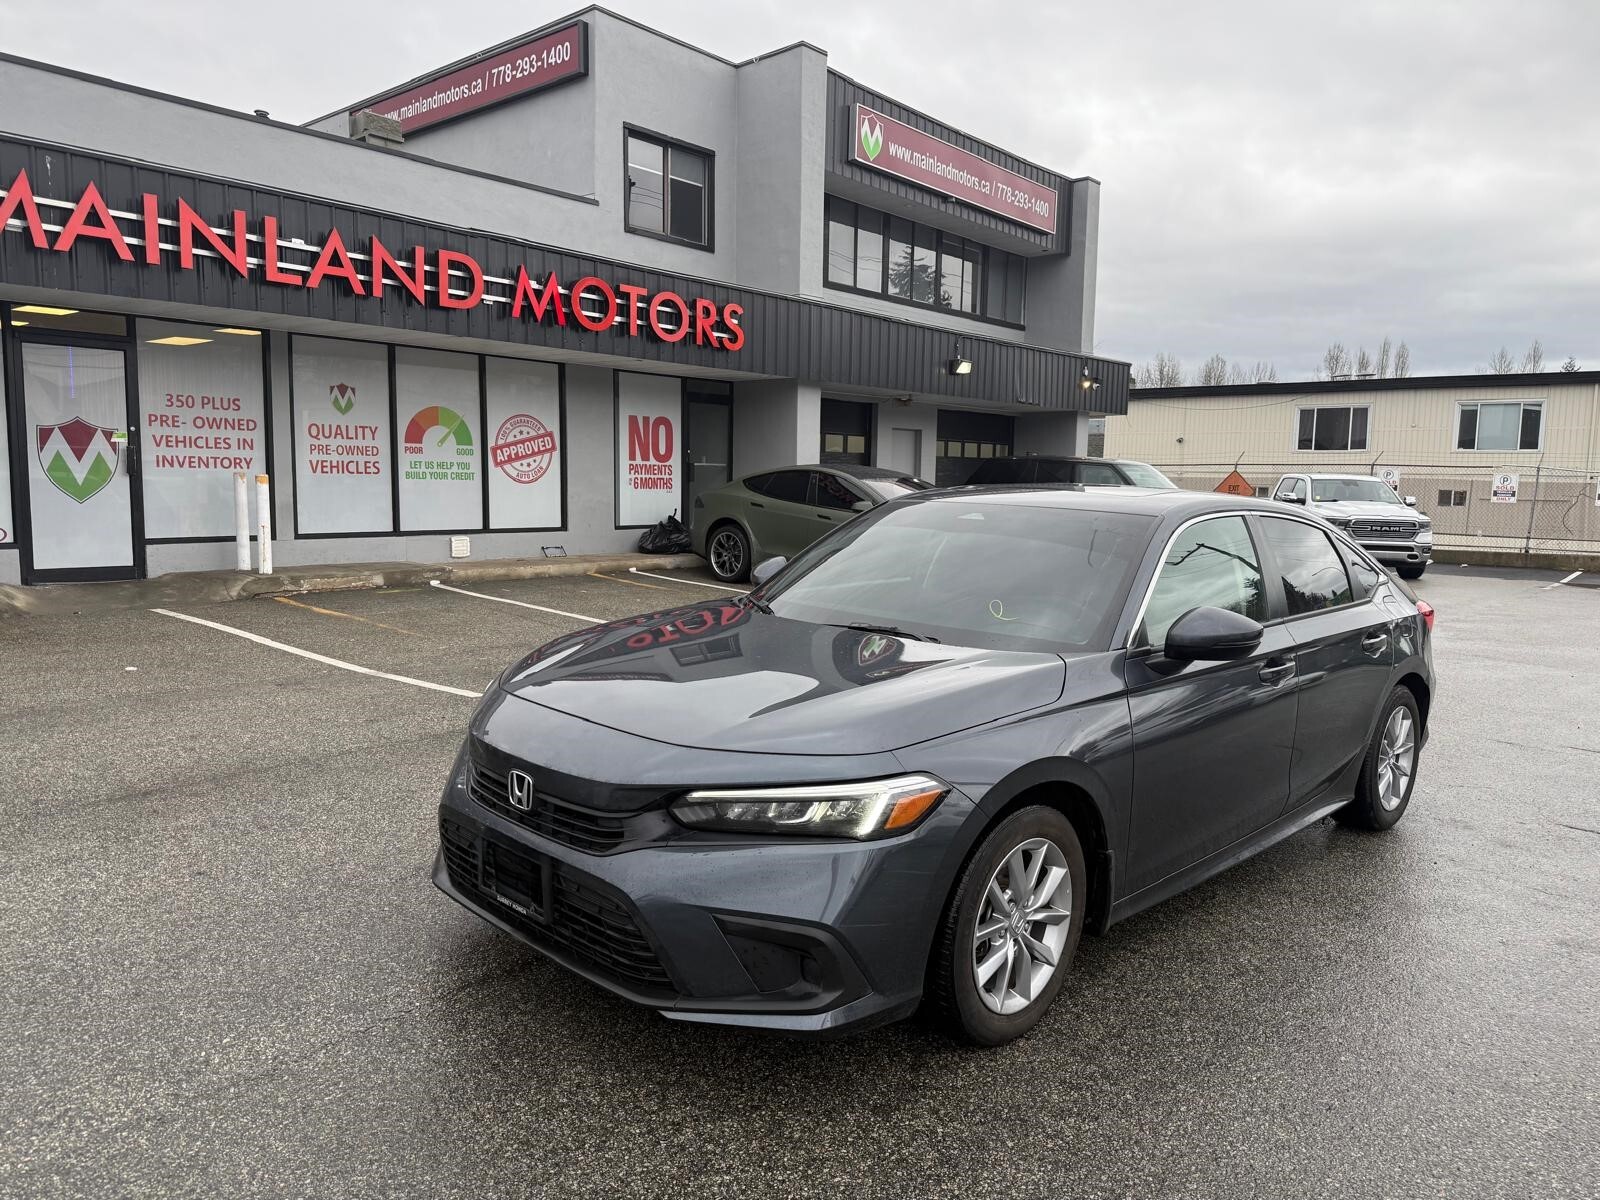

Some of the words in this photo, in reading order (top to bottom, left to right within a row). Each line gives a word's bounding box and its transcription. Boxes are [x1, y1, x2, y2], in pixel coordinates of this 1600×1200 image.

[384, 78, 483, 121] ww.mainlandmotors.ca
[491, 41, 571, 87] 778-293-1400
[888, 141, 990, 195] www.mainlandmotors.ca
[997, 182, 1049, 218] 778-293-1400
[511, 264, 745, 351] MOTORS
[165, 393, 195, 409] 350
[201, 396, 241, 411] PLUS
[192, 416, 257, 432] OWNED
[307, 423, 378, 441] QUALITY
[510, 418, 541, 432] GUARANTEED
[152, 434, 232, 450] VEHICLES
[237, 437, 254, 451] IN
[628, 414, 673, 463] NO
[309, 443, 379, 457] PRE-OWNED
[404, 446, 424, 455] POOR
[456, 448, 474, 456] GOOD
[496, 436, 552, 463] APPROVED
[155, 454, 253, 470] INVENTORY
[309, 459, 381, 475] VEHICLES
[410, 461, 424, 469] LET
[425, 461, 435, 469] US
[436, 461, 454, 470] HELP
[456, 461, 471, 470] YOU
[629, 463, 673, 476] PAYMENTS
[405, 471, 427, 480] BUILD
[428, 472, 448, 480] YOUR
[450, 472, 476, 481] CREDIT
[633, 477, 639, 489] 6
[640, 477, 673, 490] MONTHS
